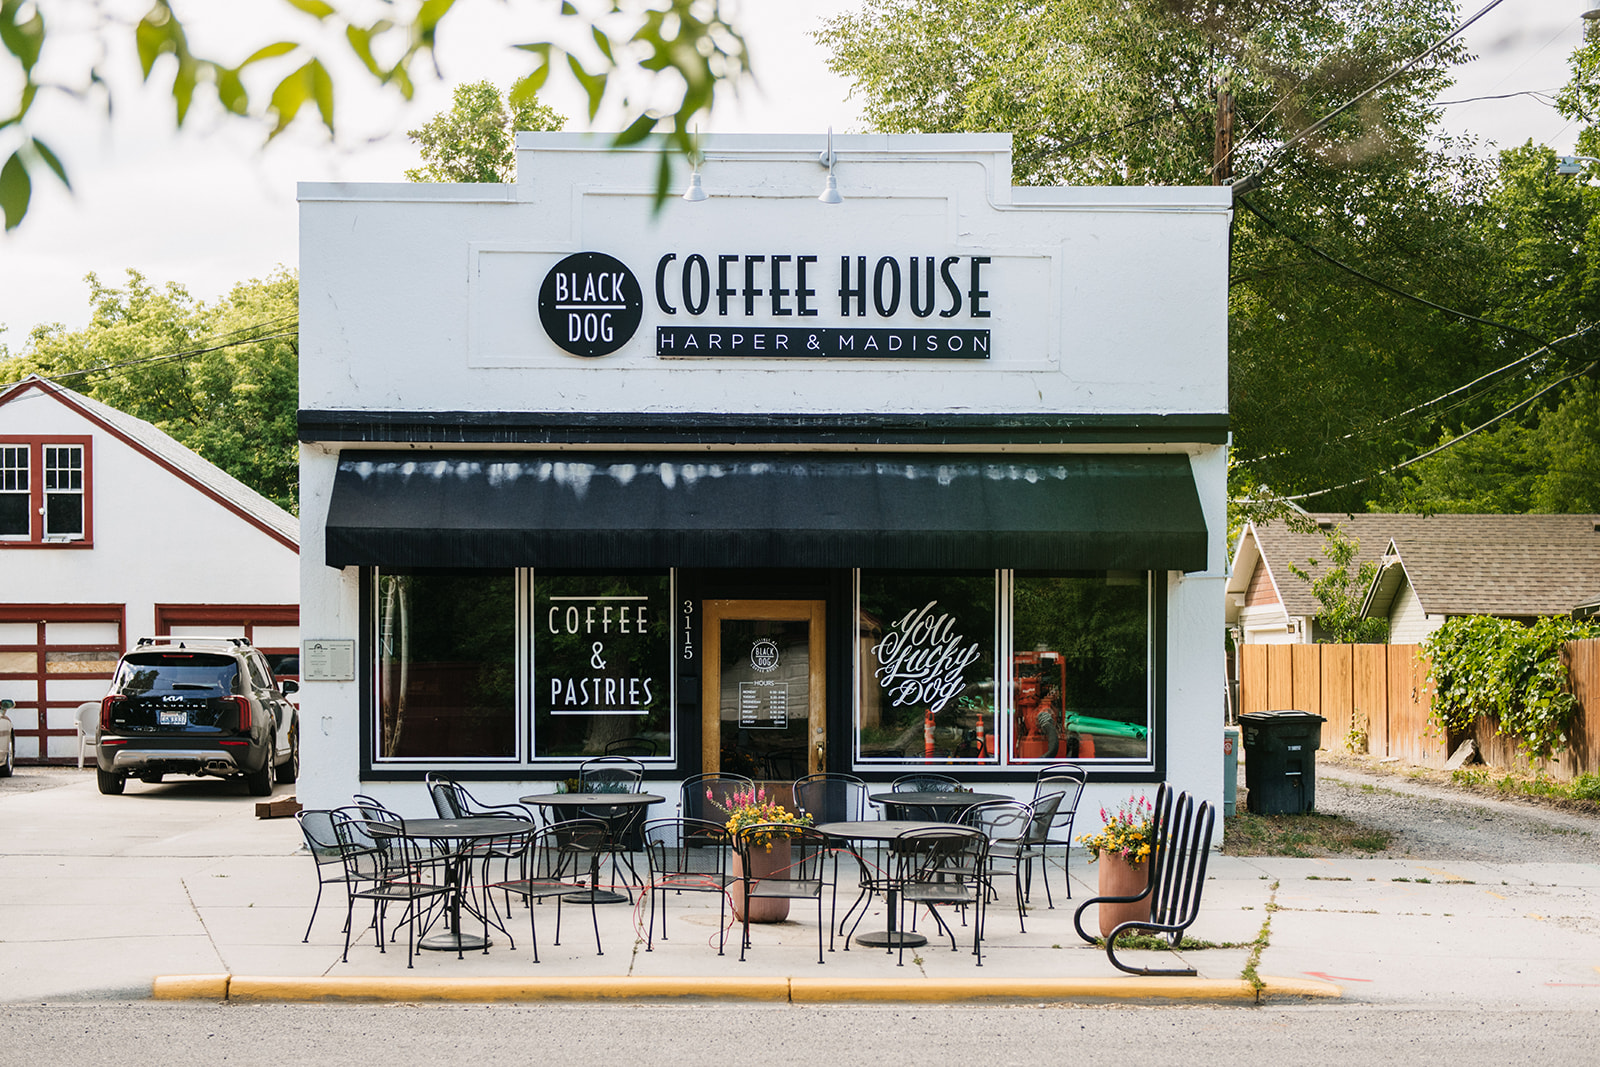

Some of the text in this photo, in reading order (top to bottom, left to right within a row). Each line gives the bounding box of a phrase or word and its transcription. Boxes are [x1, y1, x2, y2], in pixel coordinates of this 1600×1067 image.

[555, 272, 626, 302] BLACK
[655, 253, 992, 318] COFFEE HOUSE
[568, 313, 614, 343] DOG
[660, 333, 989, 351] HARPER & MADISON
[548, 606, 648, 635] COFFEE
[683, 600, 693, 660] 3115
[871, 600, 956, 665] You
[590, 641, 607, 670] &
[755, 647, 774, 656] BLACK
[758, 657, 772, 666] DOG
[875, 635, 981, 688] Lucky
[551, 677, 653, 706] PASTRIES
[888, 676, 967, 714] Dog
